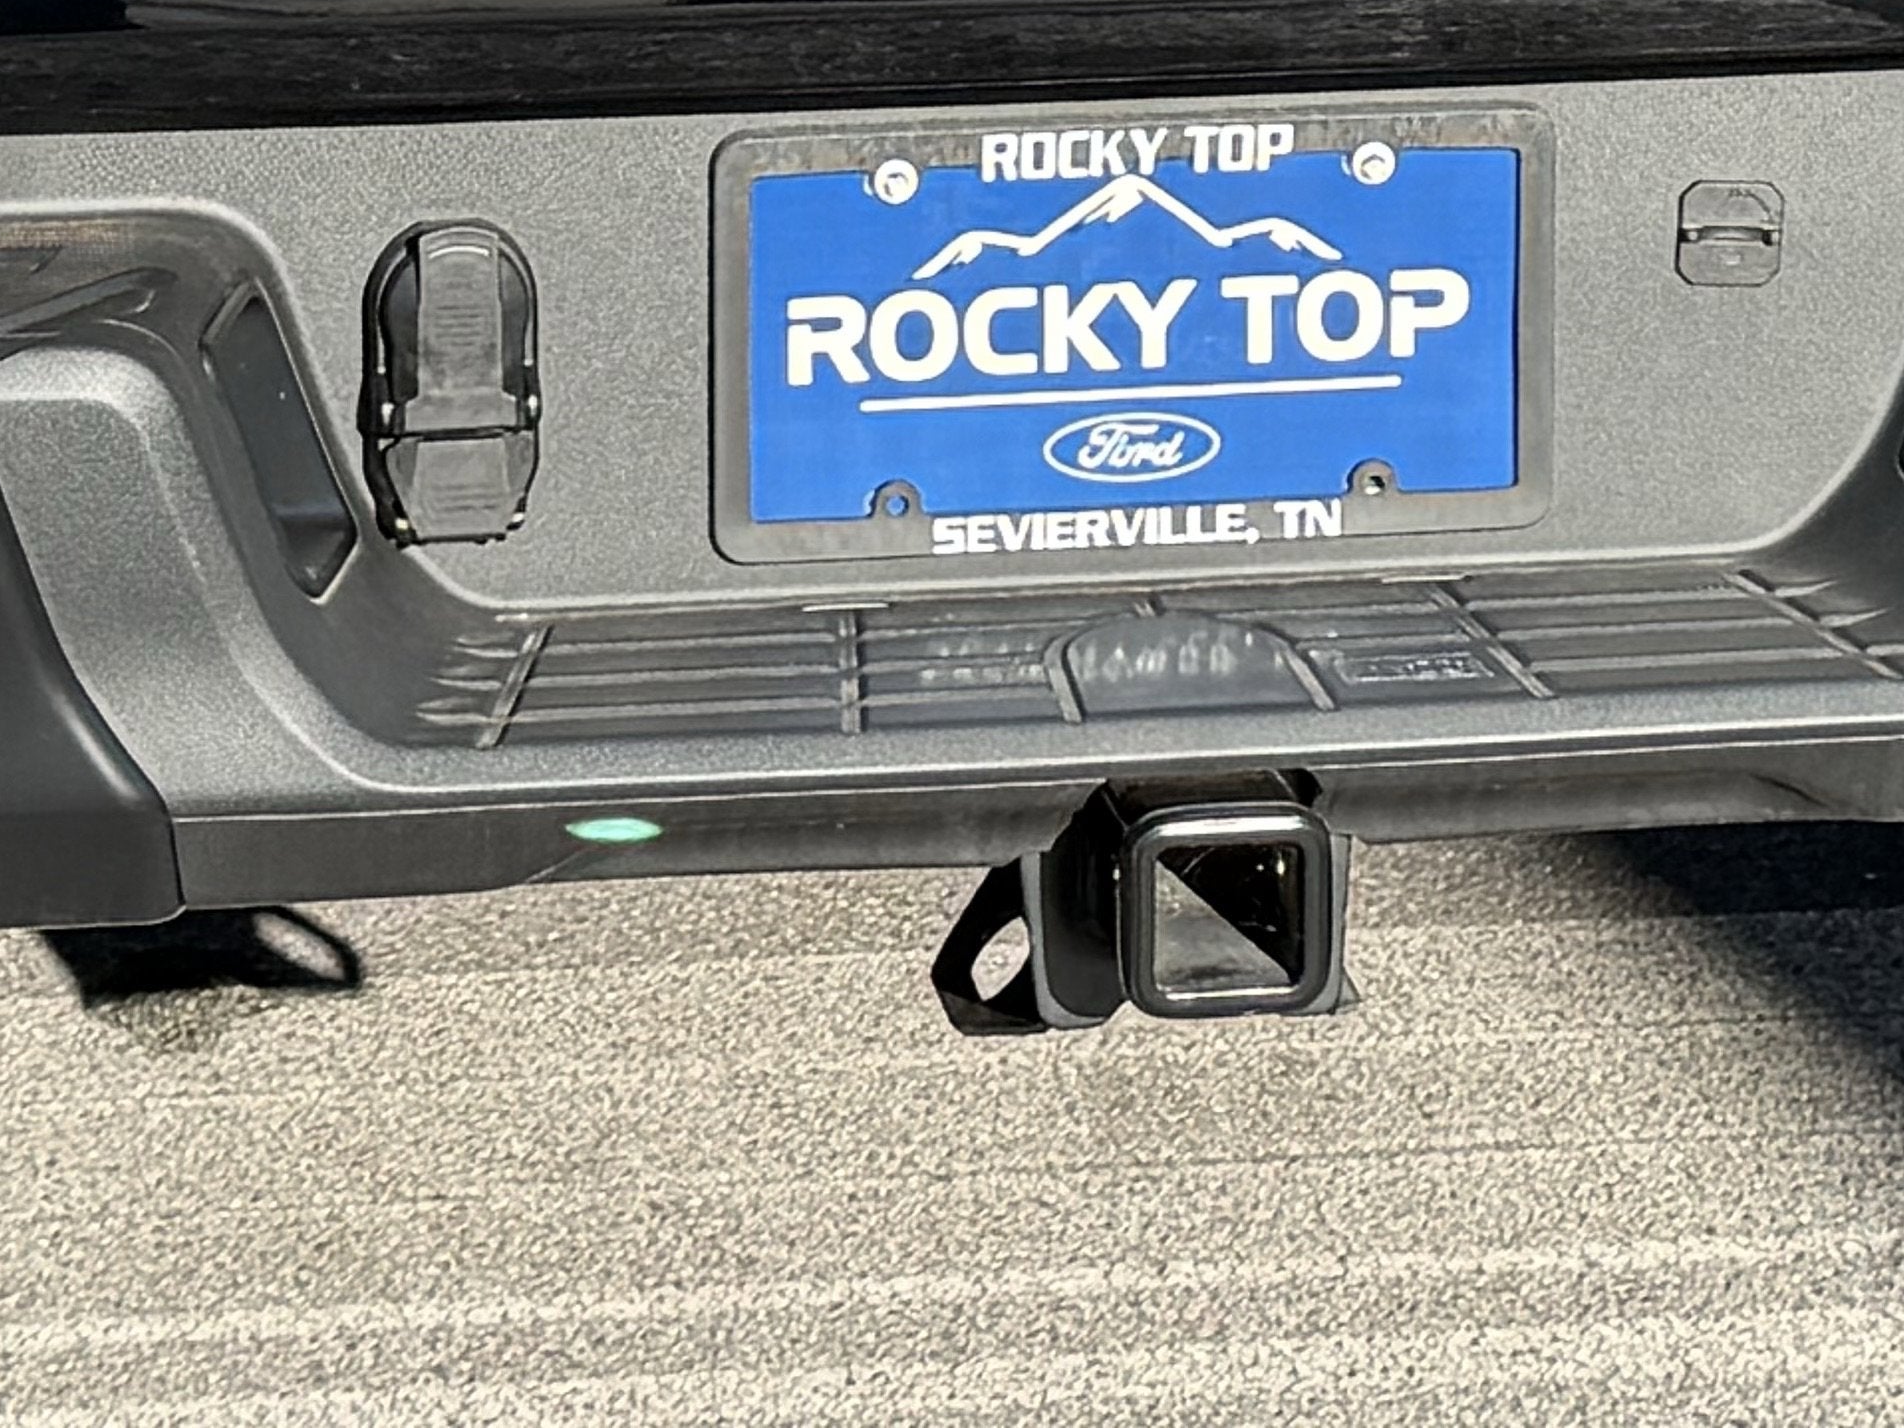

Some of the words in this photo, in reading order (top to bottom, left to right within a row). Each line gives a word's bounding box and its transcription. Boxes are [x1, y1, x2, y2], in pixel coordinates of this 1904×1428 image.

[981, 128, 1168, 183] ROCKY
[1185, 123, 1294, 173] TOP
[787, 278, 1197, 385] ROCKY
[1222, 269, 1470, 364] TOP
[1080, 423, 1184, 469] Ford
[934, 505, 1261, 556] SEVIERVILLE,
[1274, 500, 1342, 540] TN
